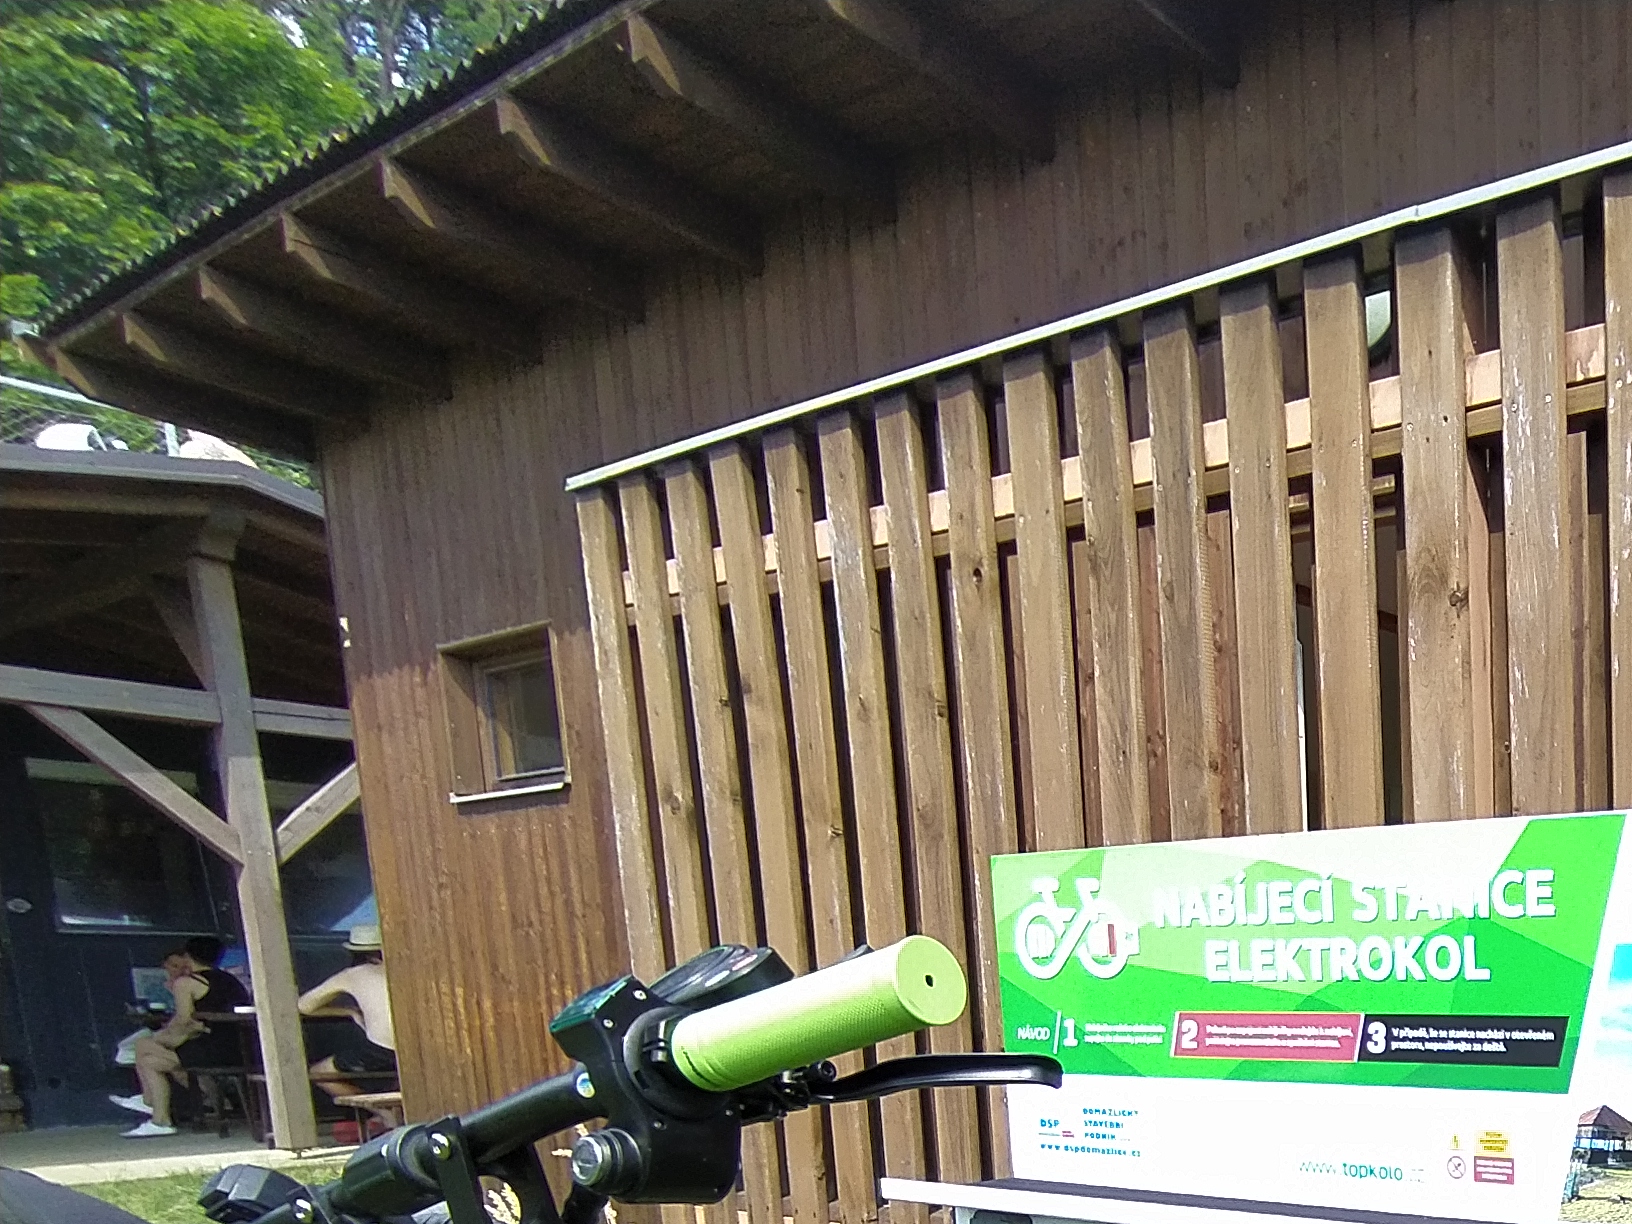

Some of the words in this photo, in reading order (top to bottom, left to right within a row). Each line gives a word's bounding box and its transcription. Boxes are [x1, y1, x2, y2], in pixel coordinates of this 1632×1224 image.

[1153, 871, 1335, 929] NABÍJECÍ
[1351, 869, 1557, 922] STANICE
[1204, 936, 1491, 982] ELEKTROKOL
[1017, 1024, 1051, 1041] NÁVOD
[1063, 1018, 1079, 1047] 1
[1180, 1020, 1199, 1049] 2
[1366, 1021, 1387, 1053] 3
[1040, 1118, 1060, 1129] DSP
